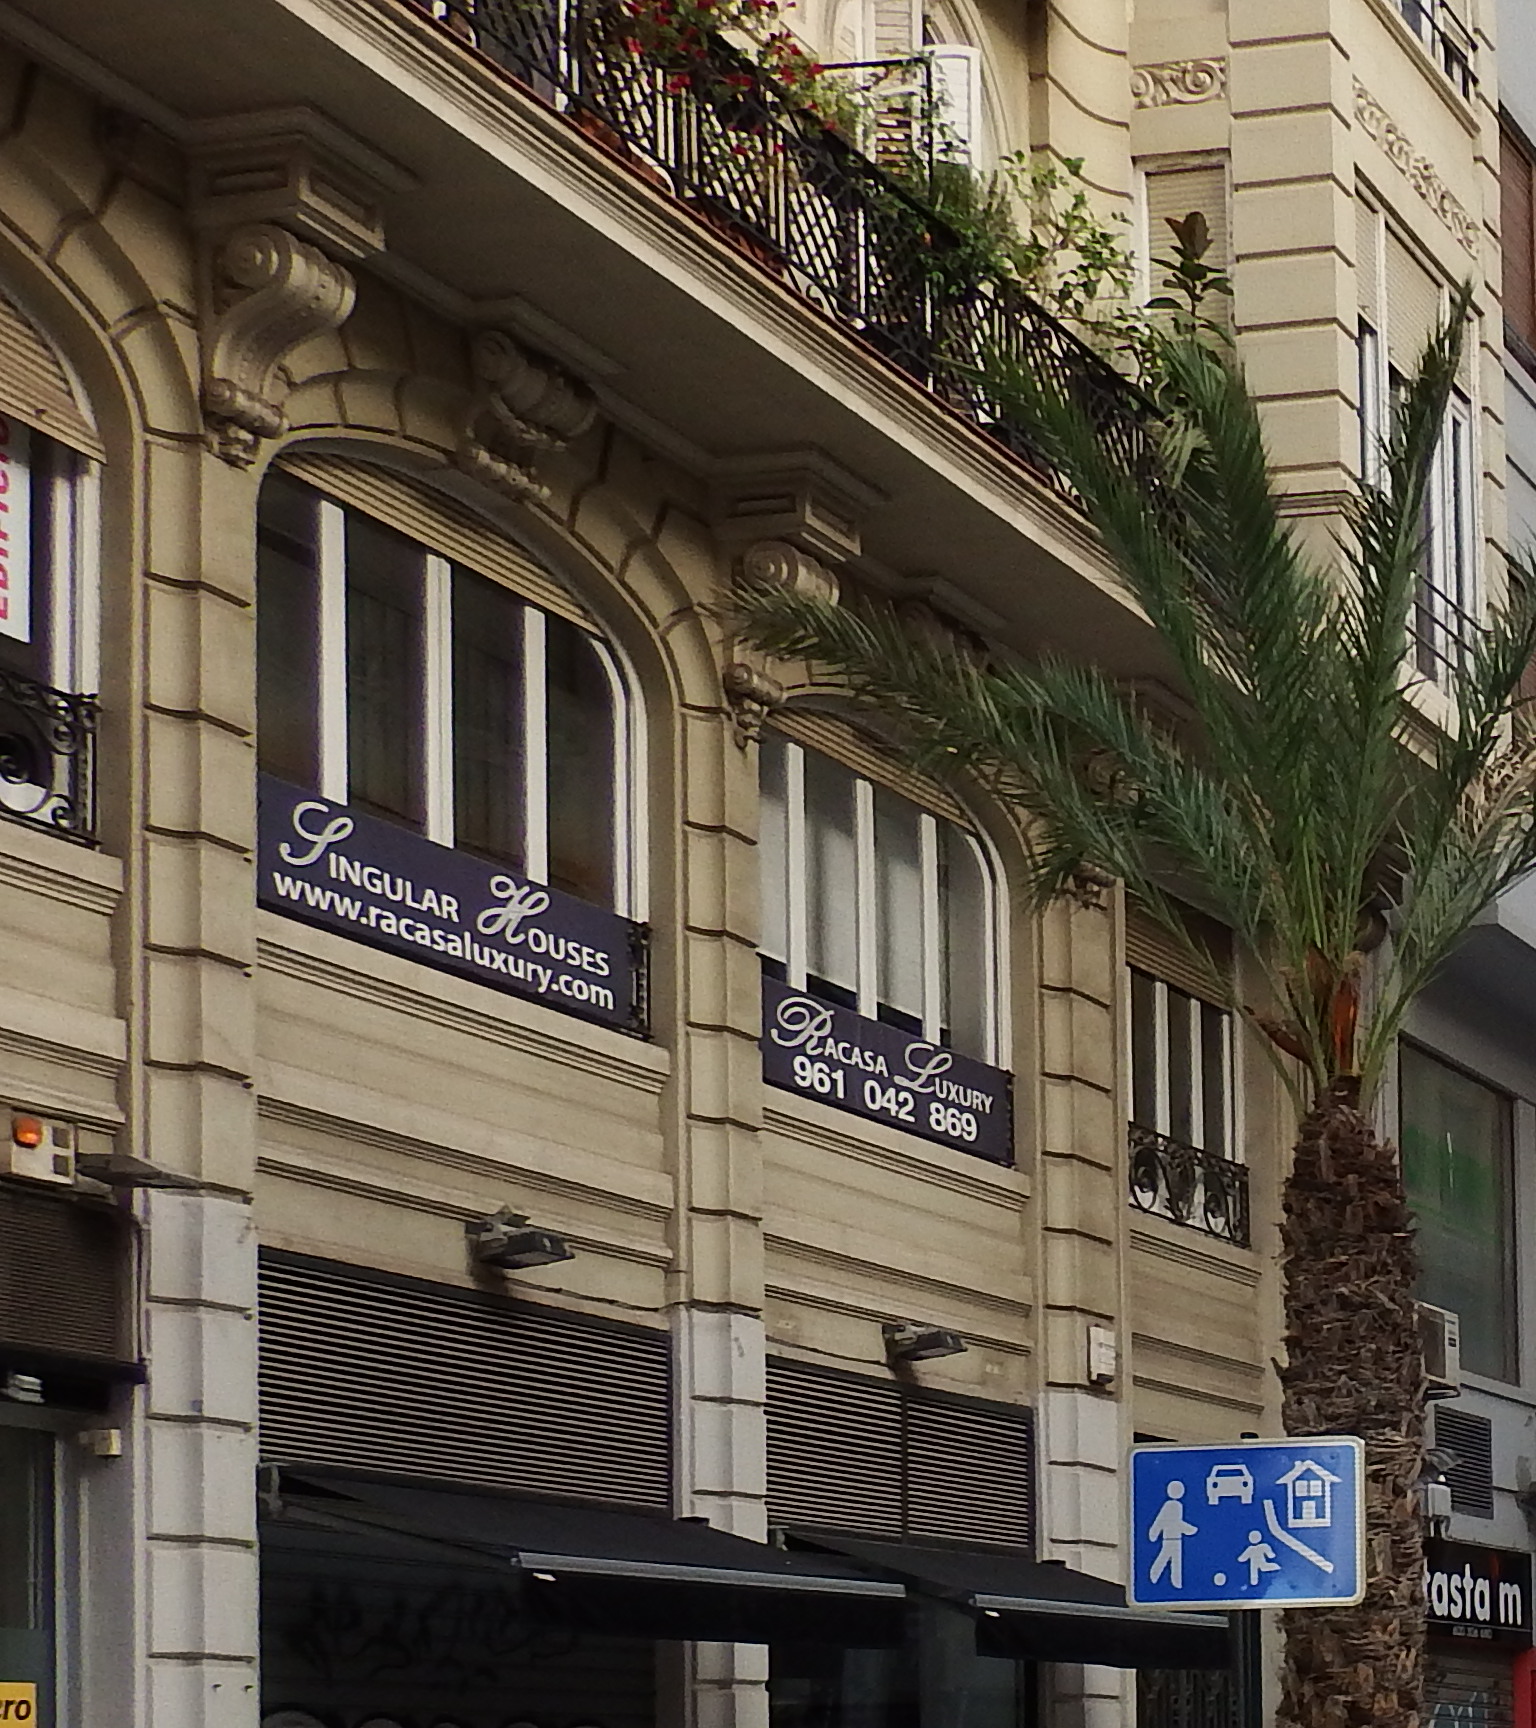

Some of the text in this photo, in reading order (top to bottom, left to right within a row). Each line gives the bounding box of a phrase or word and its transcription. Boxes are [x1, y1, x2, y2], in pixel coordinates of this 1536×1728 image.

[273, 872, 616, 1010] www.racasaluxury.com
[793, 1055, 978, 1143] 961 042 869
[0, 1698, 32, 1721] ro
